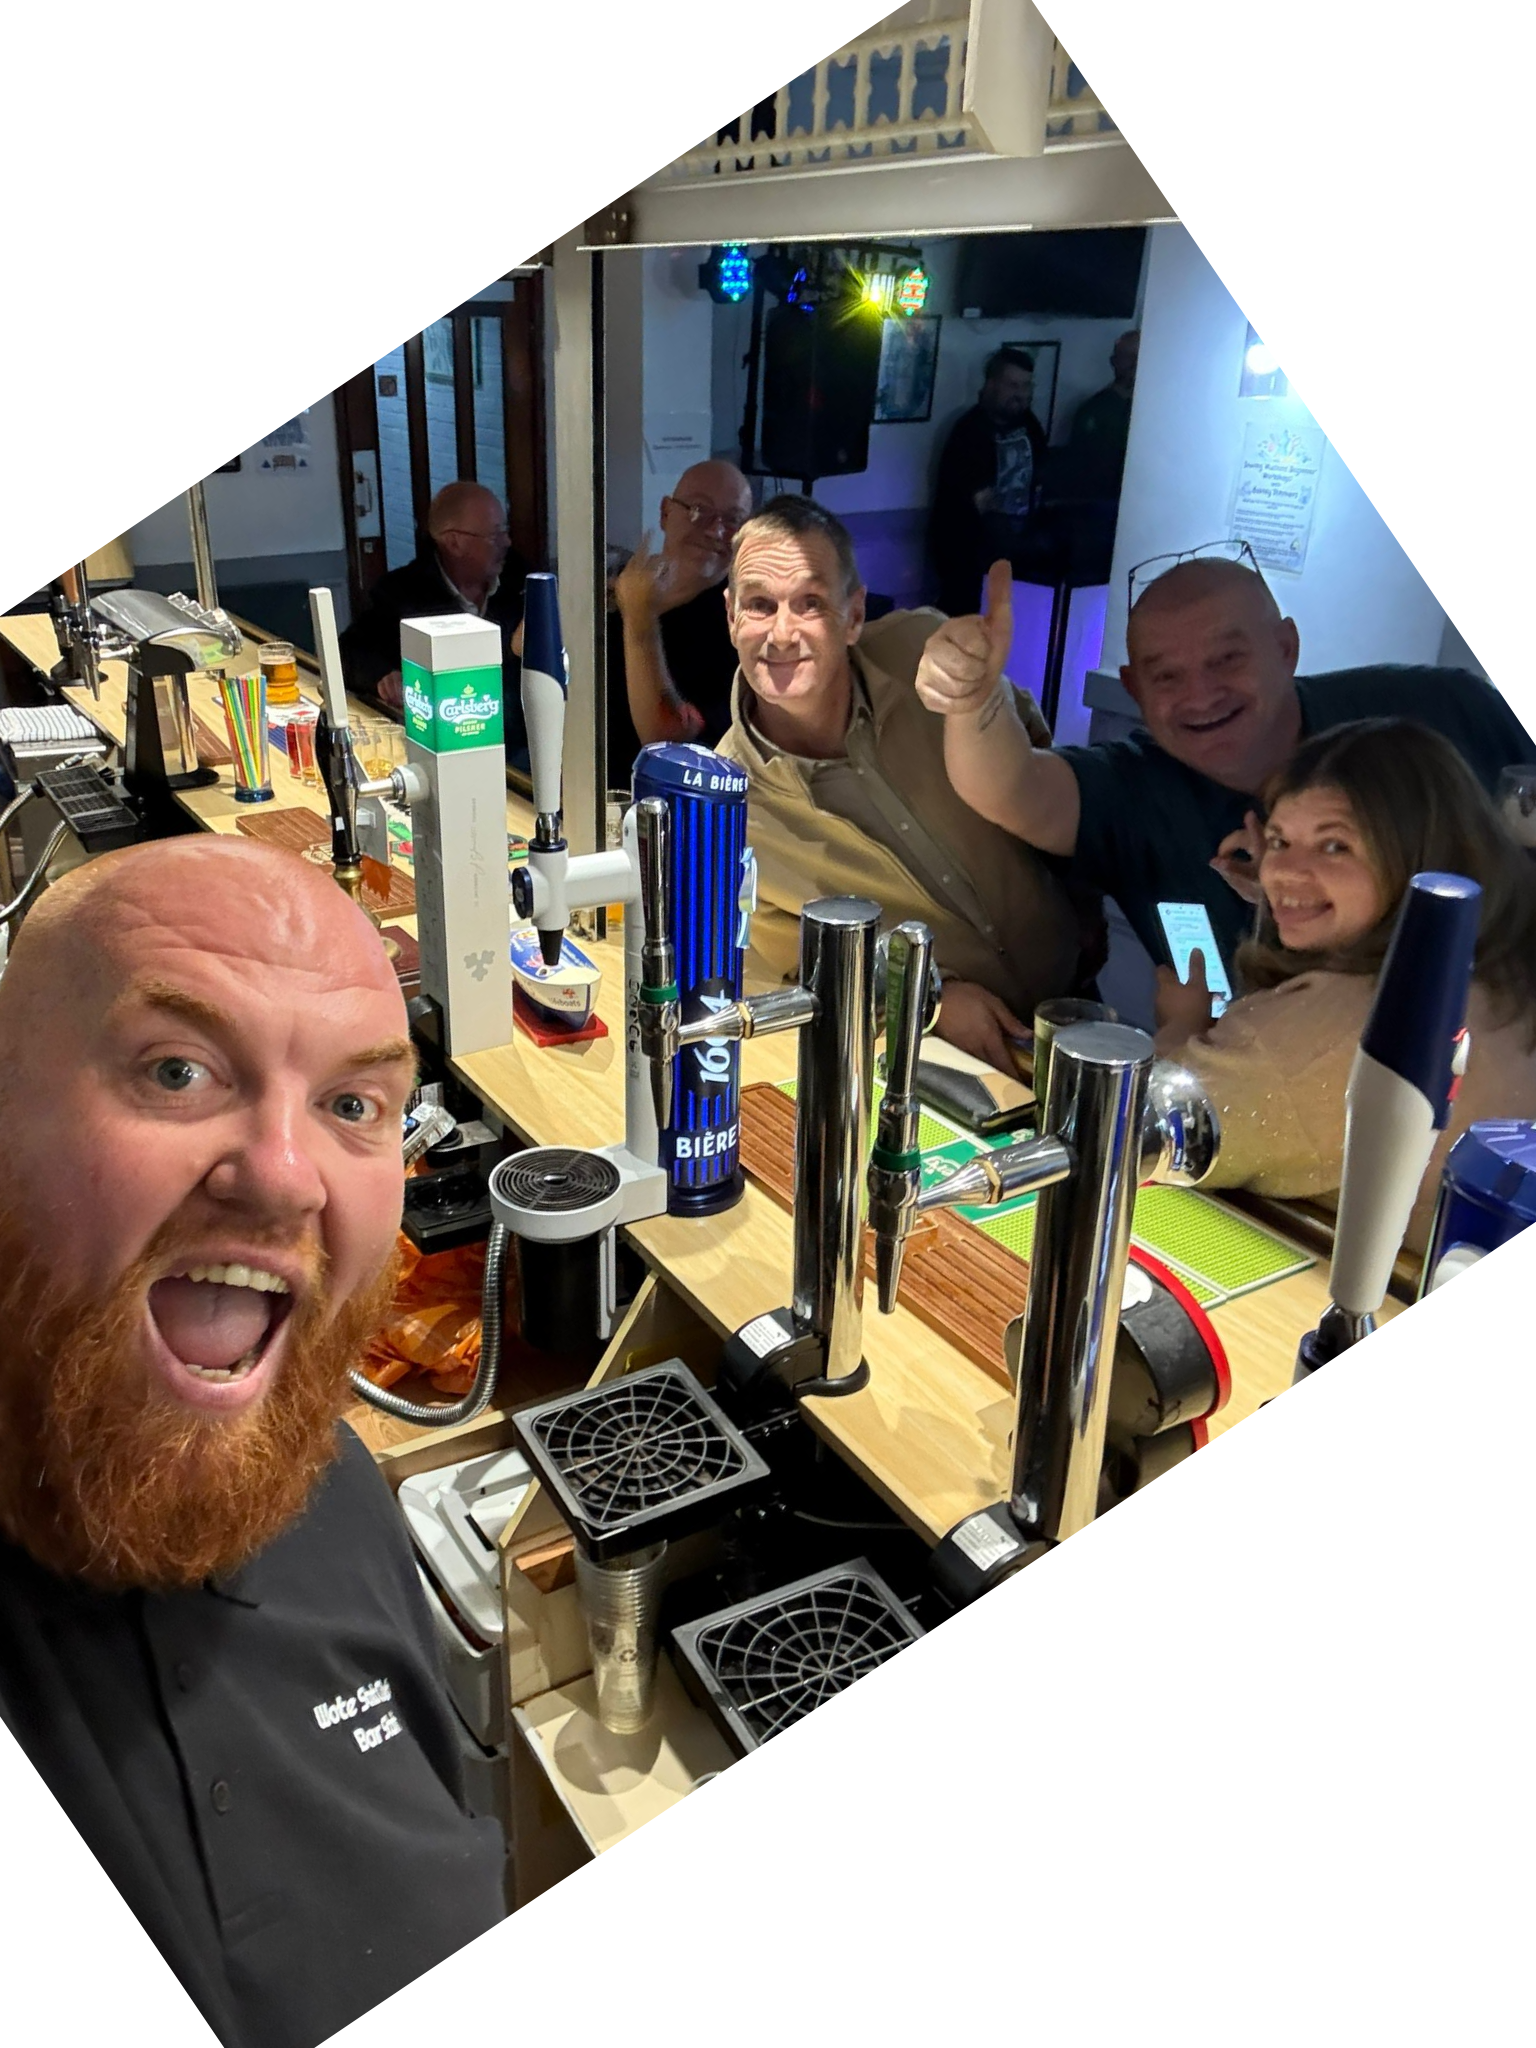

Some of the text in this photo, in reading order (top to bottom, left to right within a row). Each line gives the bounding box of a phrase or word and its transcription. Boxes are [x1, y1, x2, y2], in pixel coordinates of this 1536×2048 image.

[440, 695, 499, 724] Carlsberg
[455, 723, 485, 734] PILSNER
[683, 769, 702, 787] LA
[694, 989, 732, 1084] 164
[353, 1724, 383, 1752] Bar
